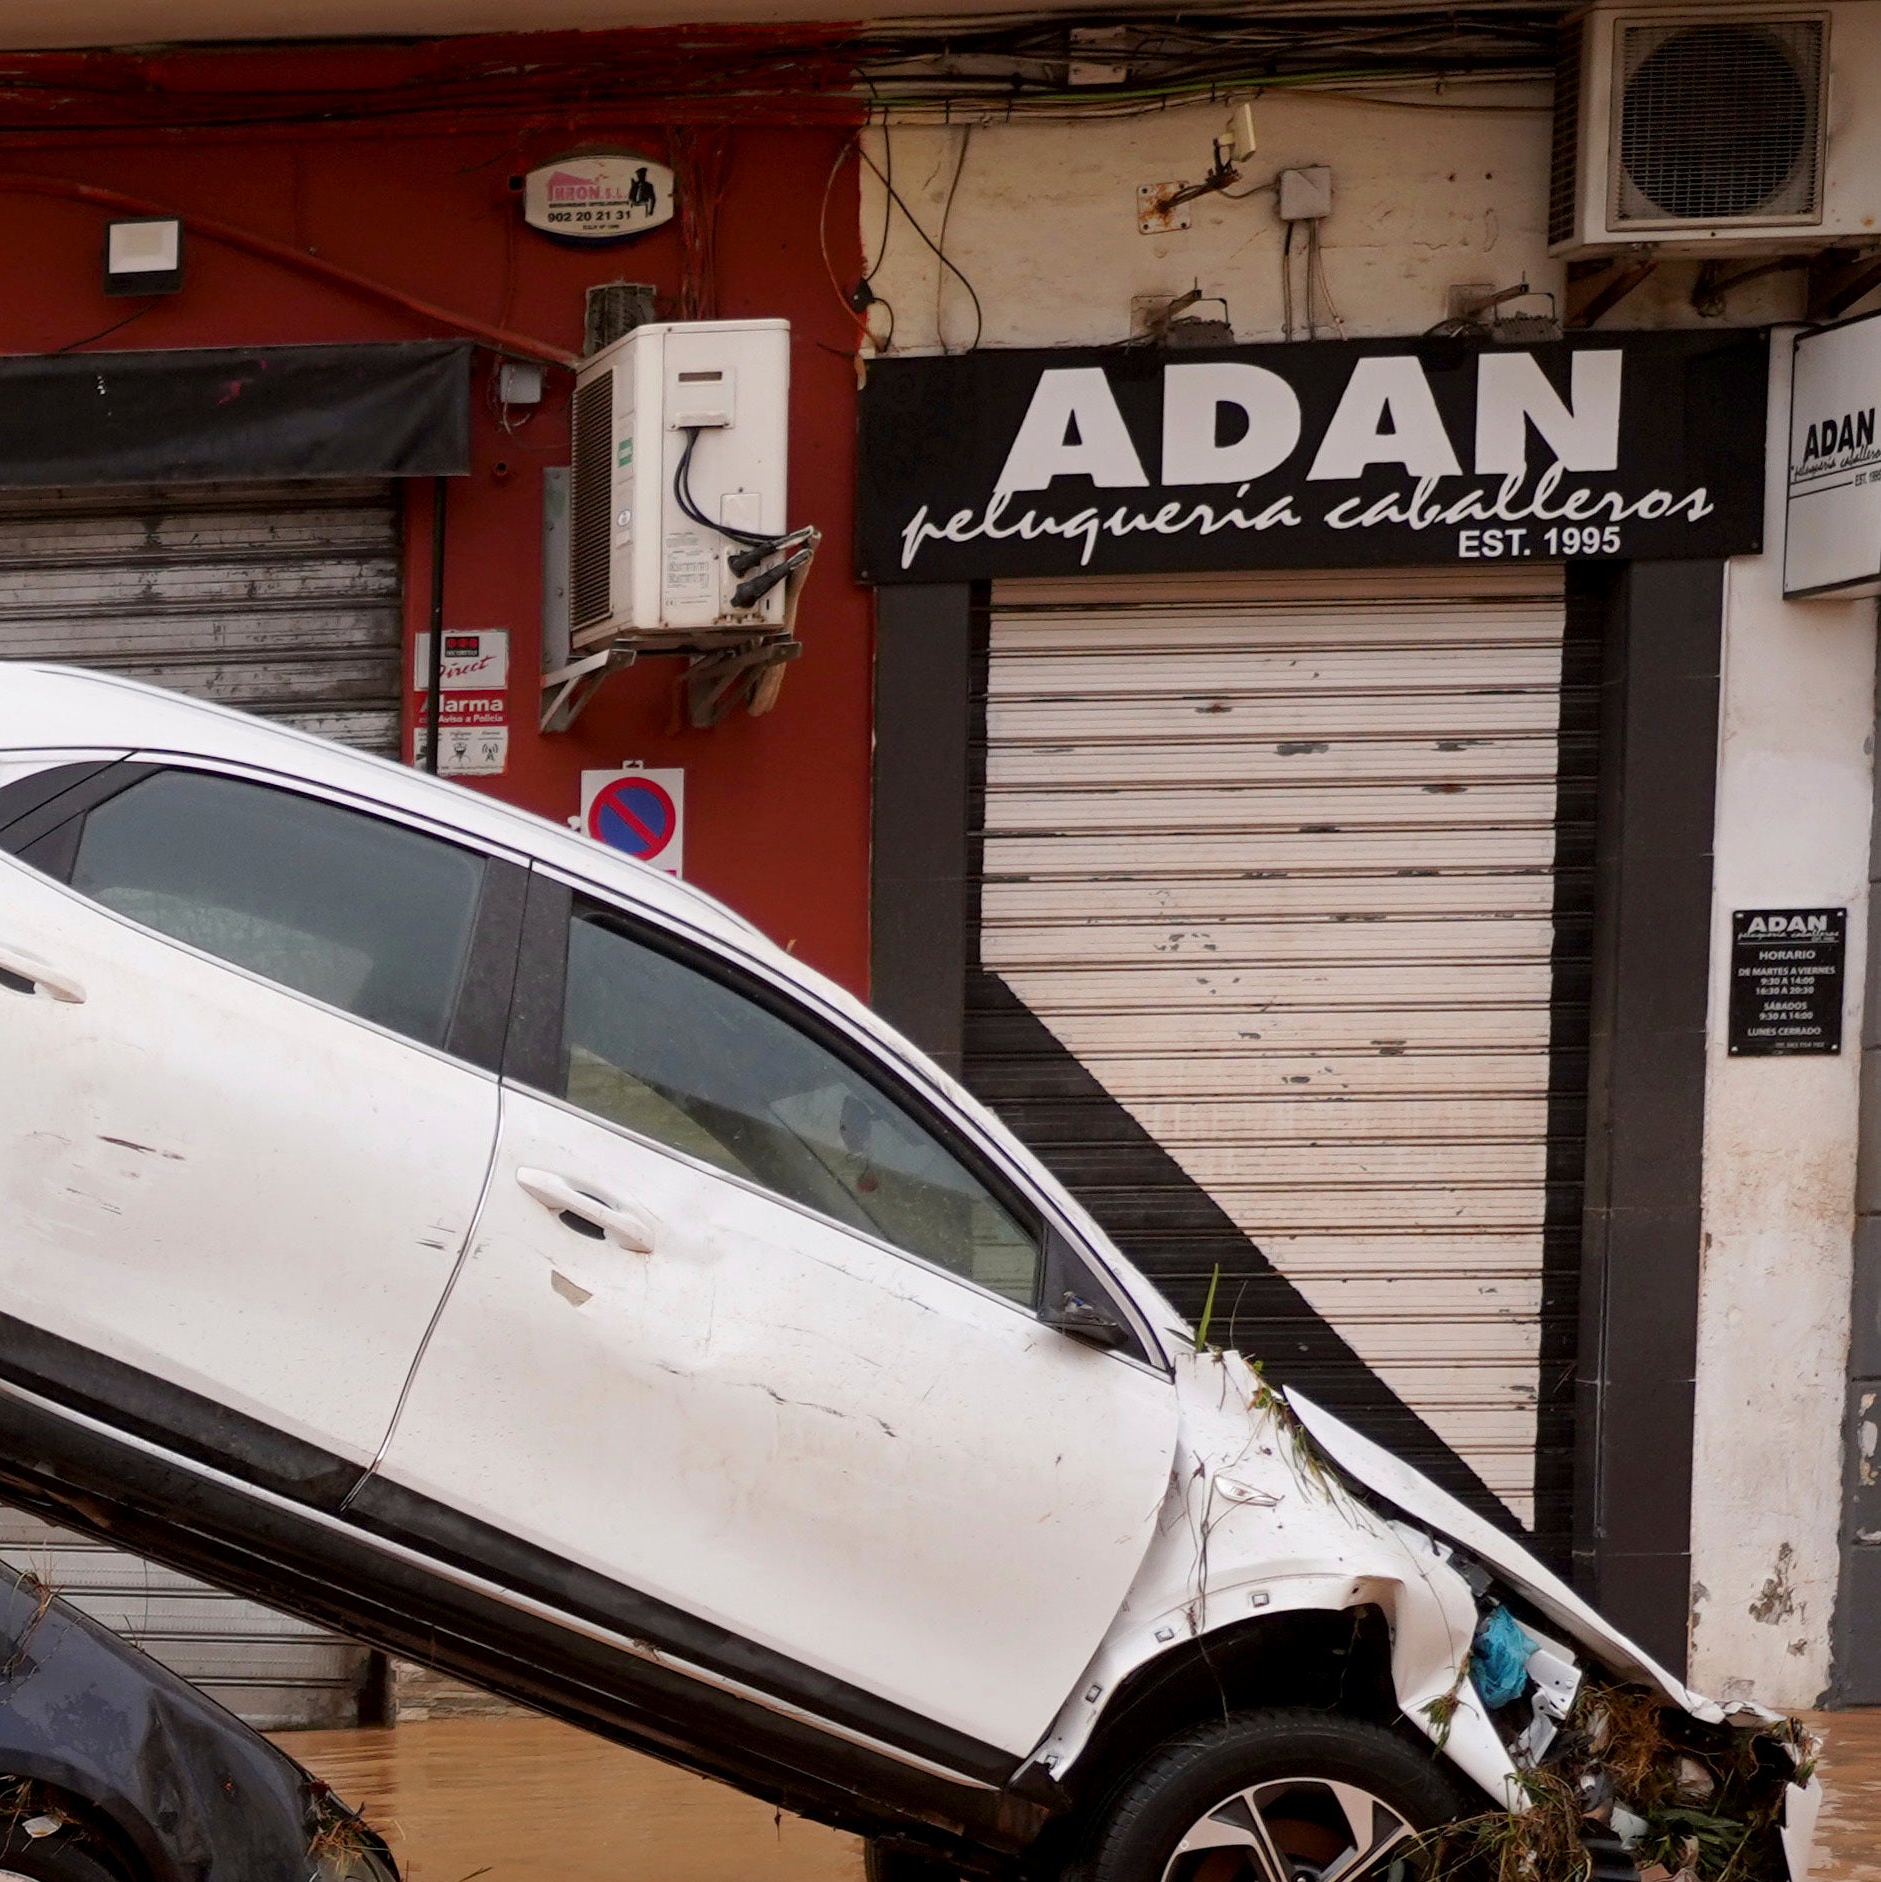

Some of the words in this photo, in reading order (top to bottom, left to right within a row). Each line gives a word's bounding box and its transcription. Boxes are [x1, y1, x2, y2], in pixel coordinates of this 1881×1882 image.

[547, 212, 572, 223] 902
[576, 211, 592, 222] 20
[596, 210, 611, 221] 21
[616, 210, 631, 220] 31
[992, 349, 1623, 492] ADAN
[1803, 408, 1875, 465] ADAN
[901, 484, 1301, 569] peluquería
[1324, 462, 1714, 530] caballeros
[1458, 528, 1531, 558] EST.
[1543, 526, 1622, 556] 1995
[1747, 915, 1828, 934] ADAN
[1759, 950, 1816, 960] HORARIO
[1738, 967, 1751, 977] DE
[1752, 967, 1789, 976] MARTES
[1789, 967, 1797, 975] A
[1797, 966, 1836, 975] VIERNES
[1780, 977, 1789, 985] A
[1780, 986, 1789, 995] A
[1779, 1011, 1787, 1020] A
[1747, 1027, 1777, 1037] LUNES
[1777, 1026, 1822, 1036] CERRADO
